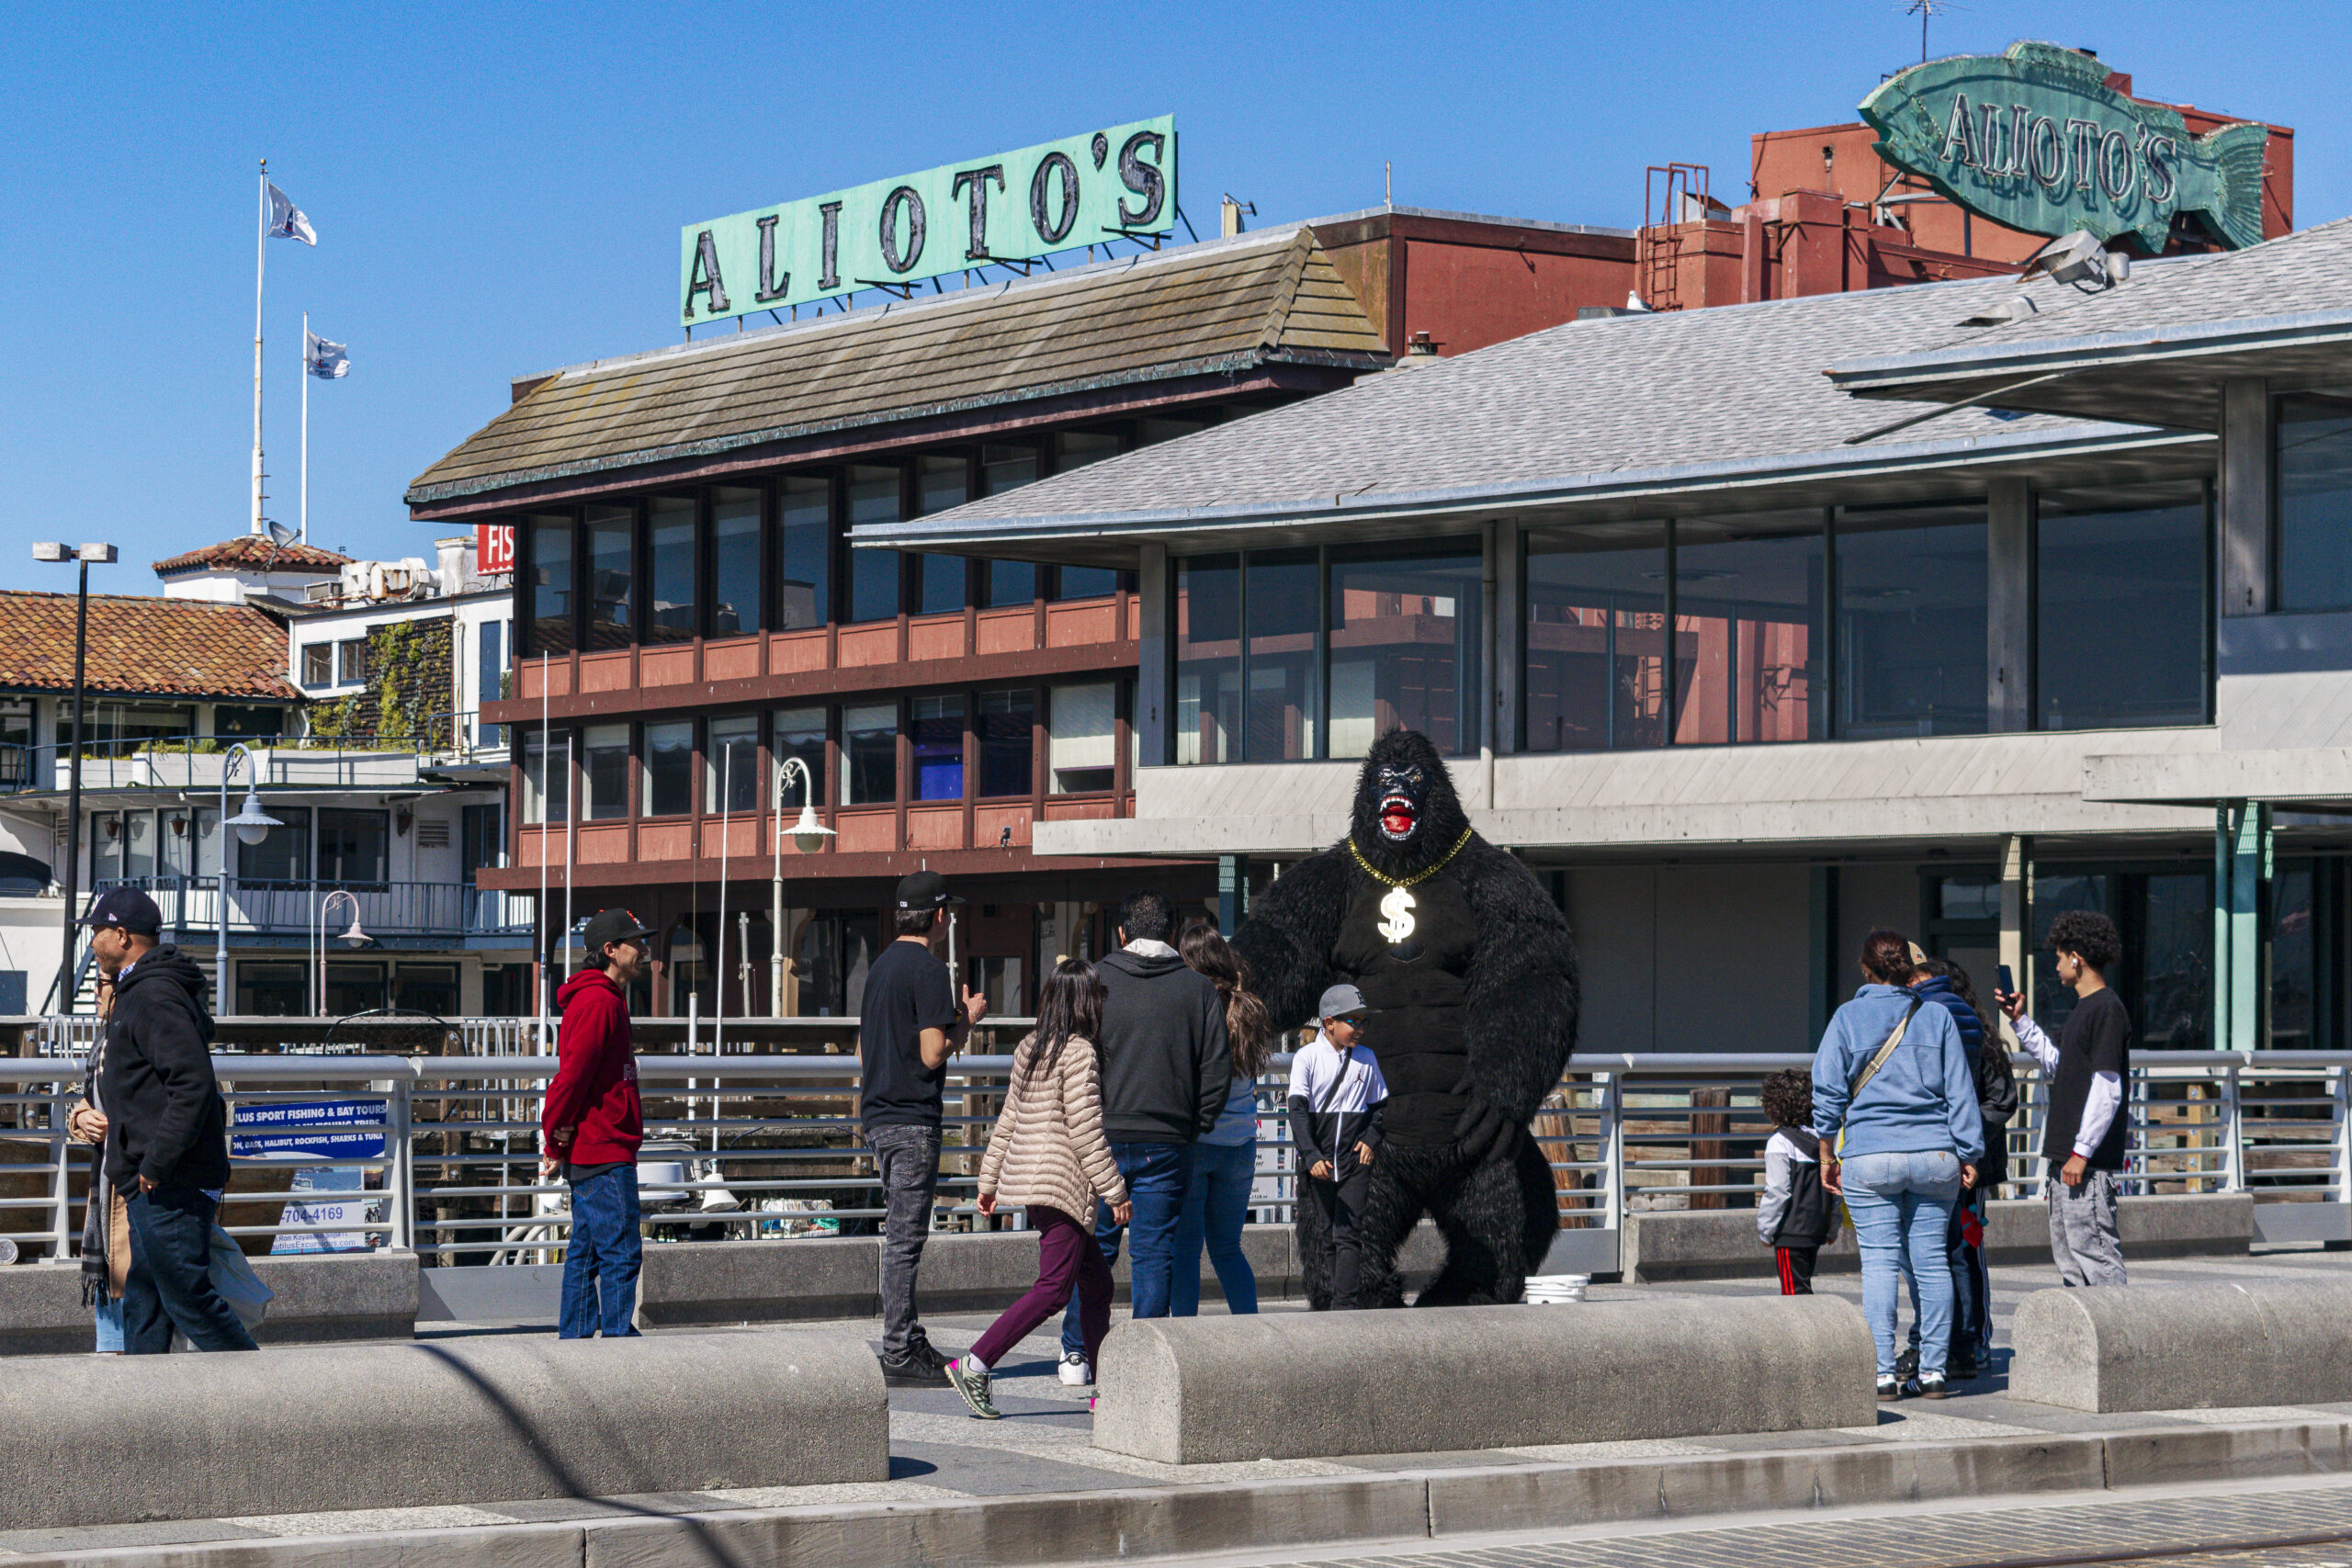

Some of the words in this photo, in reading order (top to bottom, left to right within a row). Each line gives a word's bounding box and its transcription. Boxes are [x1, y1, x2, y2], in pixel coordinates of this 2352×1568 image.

[1940, 93, 2177, 204] ALIOTO'S
[684, 130, 1165, 318] ALIOTO'S
[245, 1140, 263, 1149] BASS,
[265, 1138, 294, 1147] HALIBUT,
[295, 1135, 329, 1145] ROCKFISH,
[331, 1134, 356, 1143] SHARKS
[365, 1133, 383, 1141] TUNA
[256, 1111, 286, 1122] SPORT
[288, 1108, 325, 1120] FISHING
[327, 1107, 335, 1117] &
[337, 1106, 355, 1116] BAY
[356, 1104, 386, 1115] TOURS
